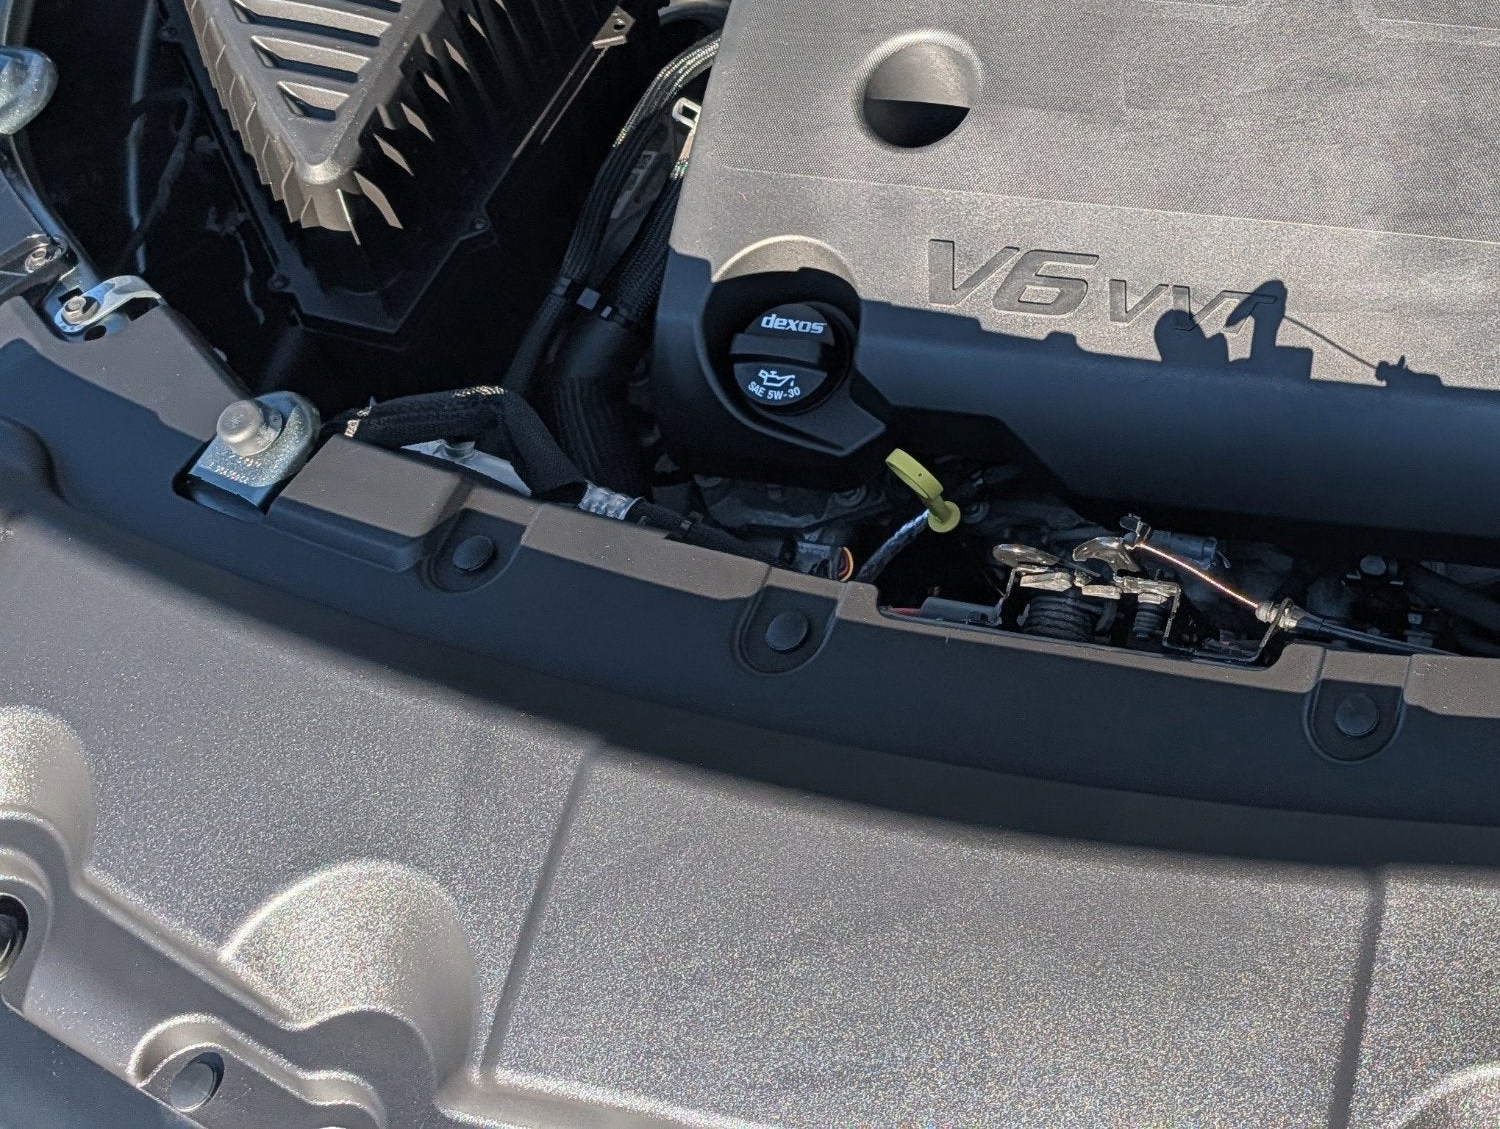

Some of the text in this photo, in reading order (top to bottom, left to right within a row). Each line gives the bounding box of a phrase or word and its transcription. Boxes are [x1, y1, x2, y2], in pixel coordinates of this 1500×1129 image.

[928, 239, 1100, 316] V6
[761, 314, 828, 334] dexos
[748, 381, 801, 400] SAE 5W-30
